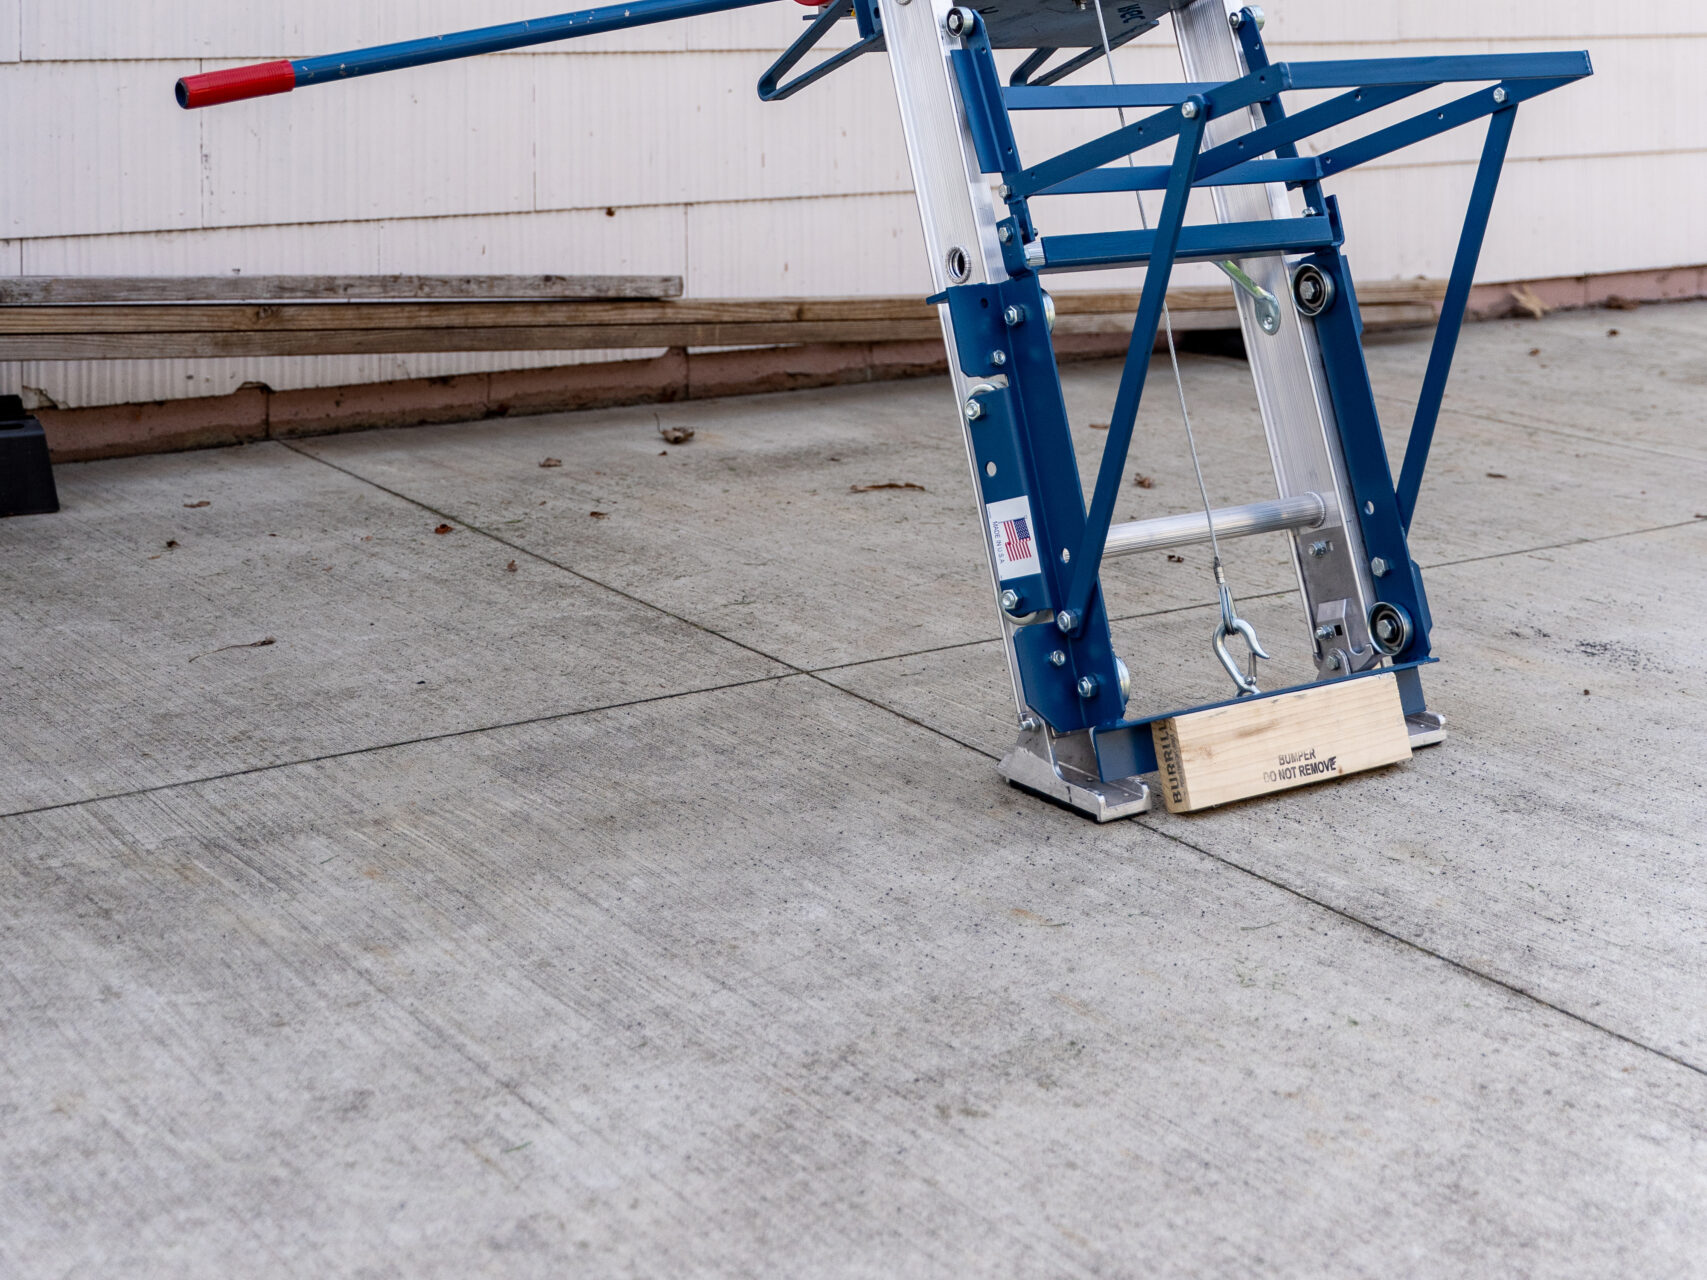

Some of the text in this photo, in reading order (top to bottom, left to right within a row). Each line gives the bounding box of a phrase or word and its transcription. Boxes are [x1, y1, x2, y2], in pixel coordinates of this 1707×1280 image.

[992, 520, 1001, 539] MADE
[1159, 718, 1183, 804] BURRILL
[1278, 748, 1317, 766] BUMPER
[1278, 766, 1297, 781] NOT
[1299, 756, 1337, 777] REMOVE
